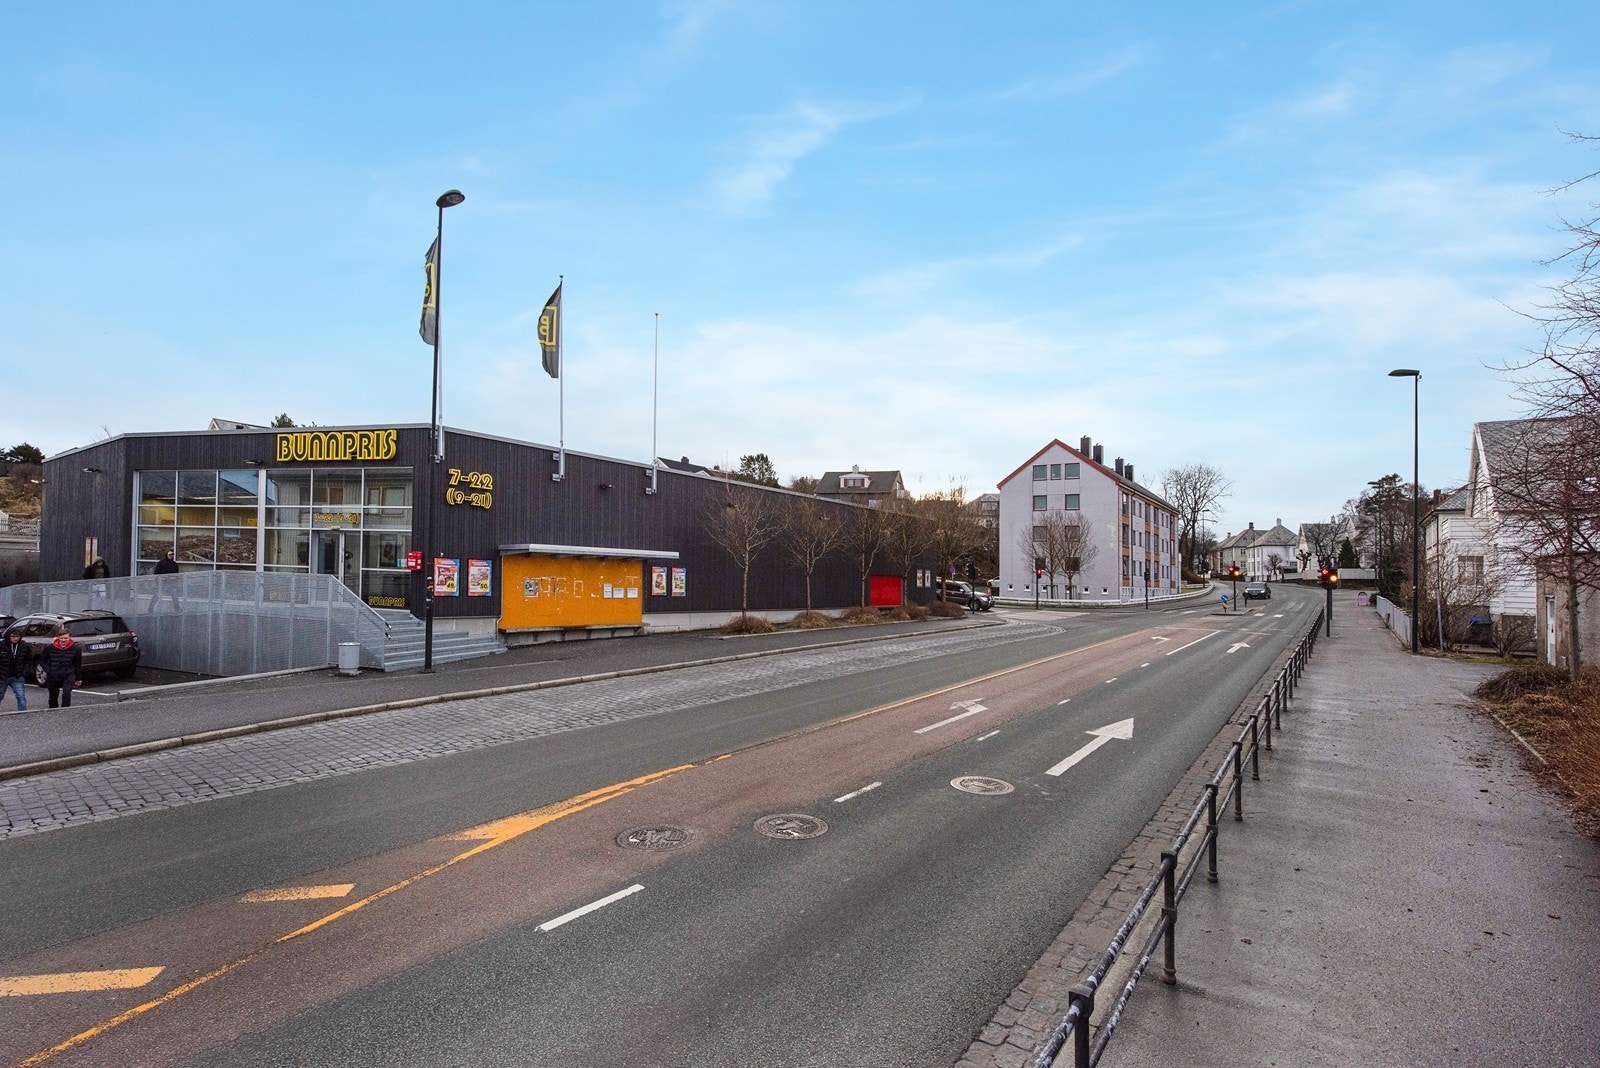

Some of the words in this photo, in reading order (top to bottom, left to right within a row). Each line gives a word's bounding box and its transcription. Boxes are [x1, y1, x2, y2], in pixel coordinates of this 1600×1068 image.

[276, 429, 397, 461] BUNNPRIS
[448, 468, 493, 490] 7-22
[446, 487, 493, 509] (9-21)
